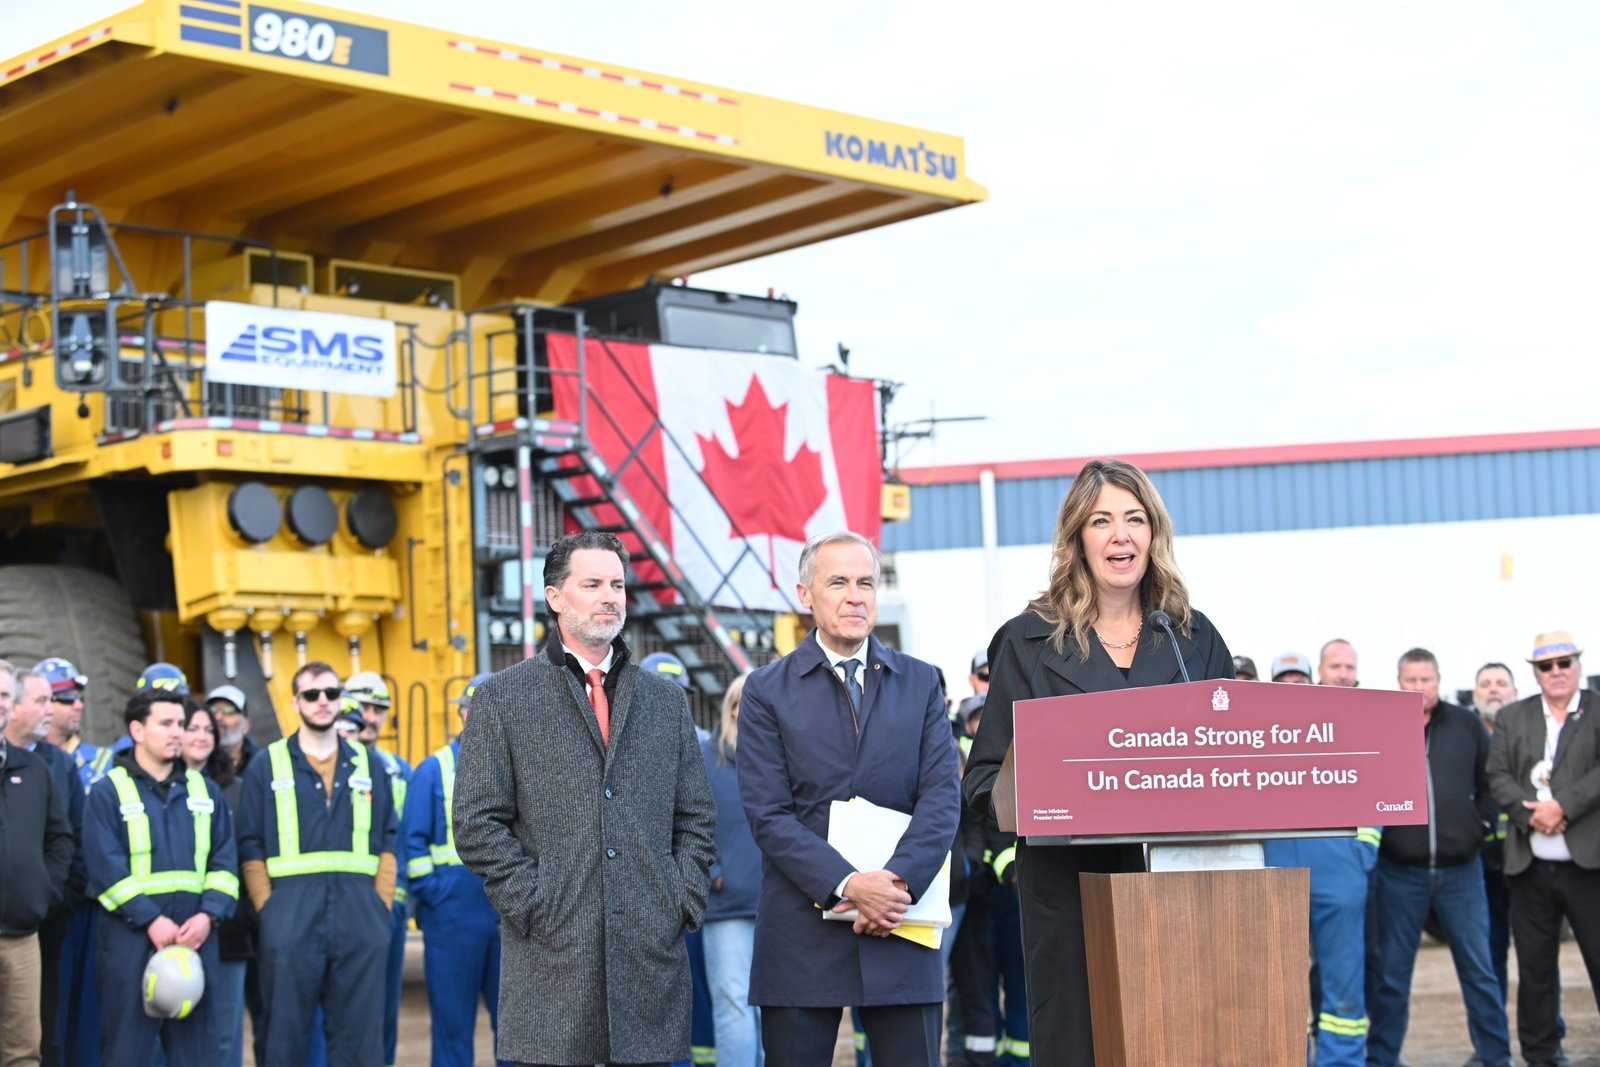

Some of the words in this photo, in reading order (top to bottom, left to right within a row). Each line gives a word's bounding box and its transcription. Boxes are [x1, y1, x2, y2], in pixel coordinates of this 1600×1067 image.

[251, 12, 353, 65] 980E
[825, 130, 956, 180] KOMATSU
[261, 326, 383, 362] SMS
[261, 355, 383, 376] EQUIPMENT
[1108, 727, 1188, 748] Canada
[1194, 726, 1264, 748] Strong
[1270, 725, 1301, 744] for
[1306, 723, 1334, 742] All
[1087, 771, 1118, 790] Un
[1124, 768, 1204, 789] Canada
[1210, 768, 1250, 787] fort
[1256, 770, 1306, 790] pour
[1311, 767, 1358, 784] tous
[1376, 800, 1414, 811] Canada
